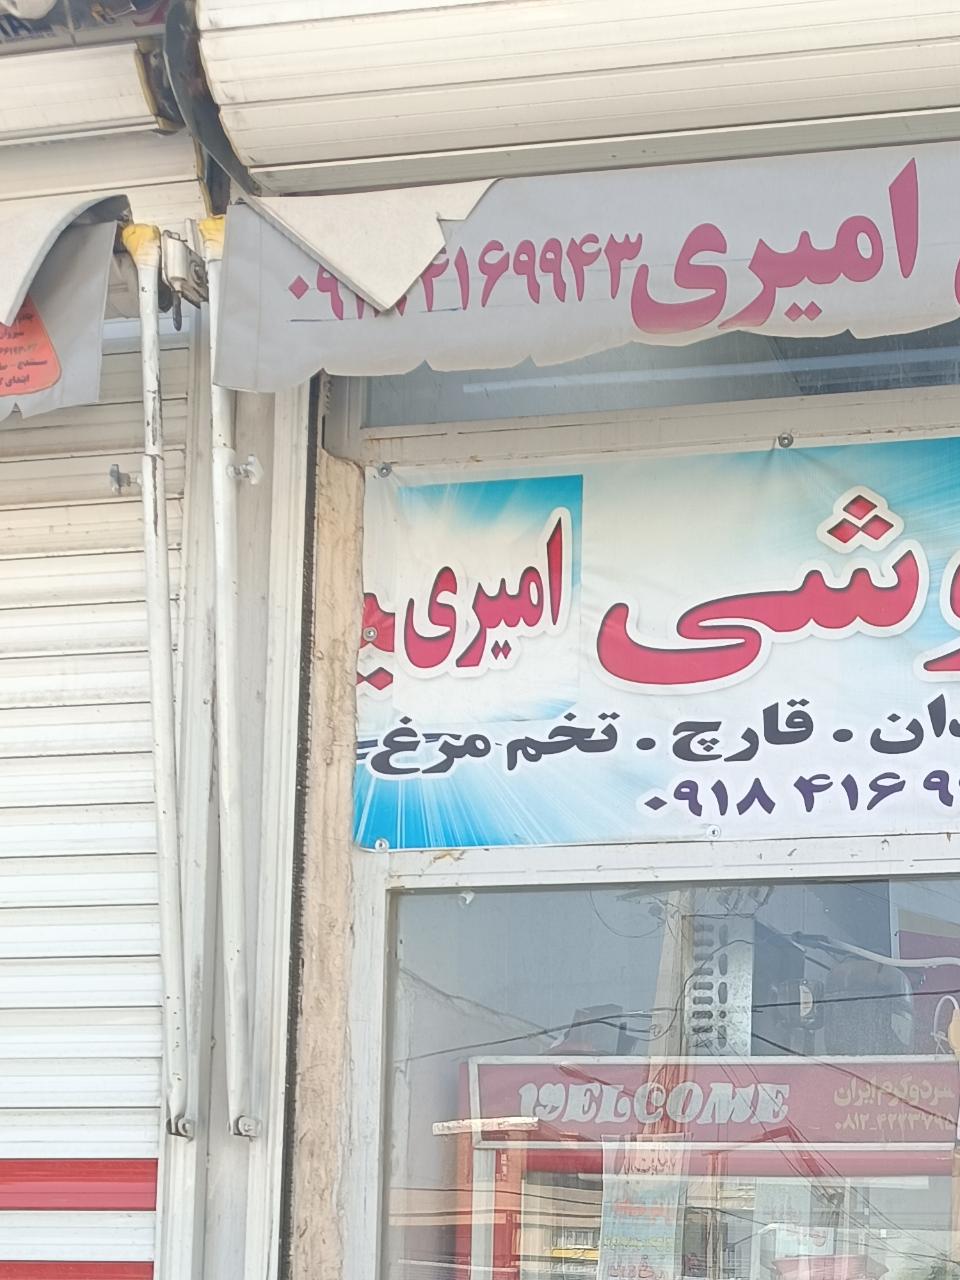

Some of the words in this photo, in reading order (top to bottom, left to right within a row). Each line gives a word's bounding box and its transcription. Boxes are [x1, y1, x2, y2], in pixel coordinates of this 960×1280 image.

[287, 232, 644, 322] ۰۹۴۱۶۹۹۴۳
[629, 157, 919, 336] امیری
[403, 515, 564, 670] امیری
[370, 715, 492, 776] مرغ
[506, 710, 621, 772] تخم
[671, 698, 815, 763] قارچ
[518, 1081, 791, 1126] WELCOME
